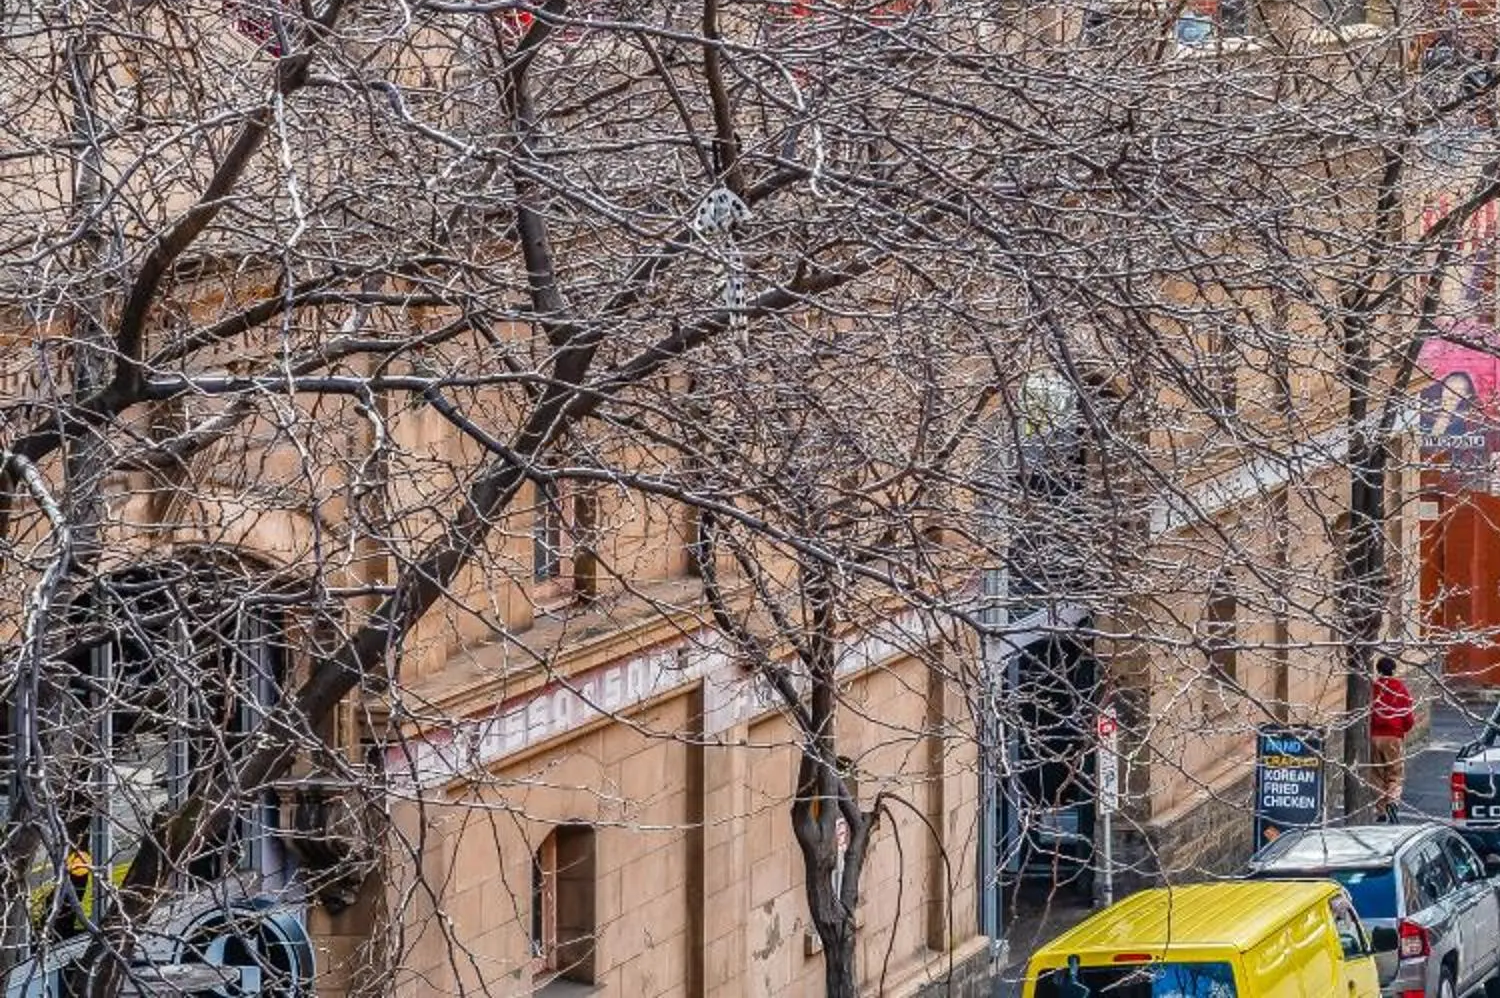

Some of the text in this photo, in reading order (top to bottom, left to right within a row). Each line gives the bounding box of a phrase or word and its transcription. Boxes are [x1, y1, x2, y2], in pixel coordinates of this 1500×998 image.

[1263, 769, 1315, 783] KOREAN
[1263, 782, 1299, 795] FRIED
[1263, 795, 1315, 809] CHICKEN
